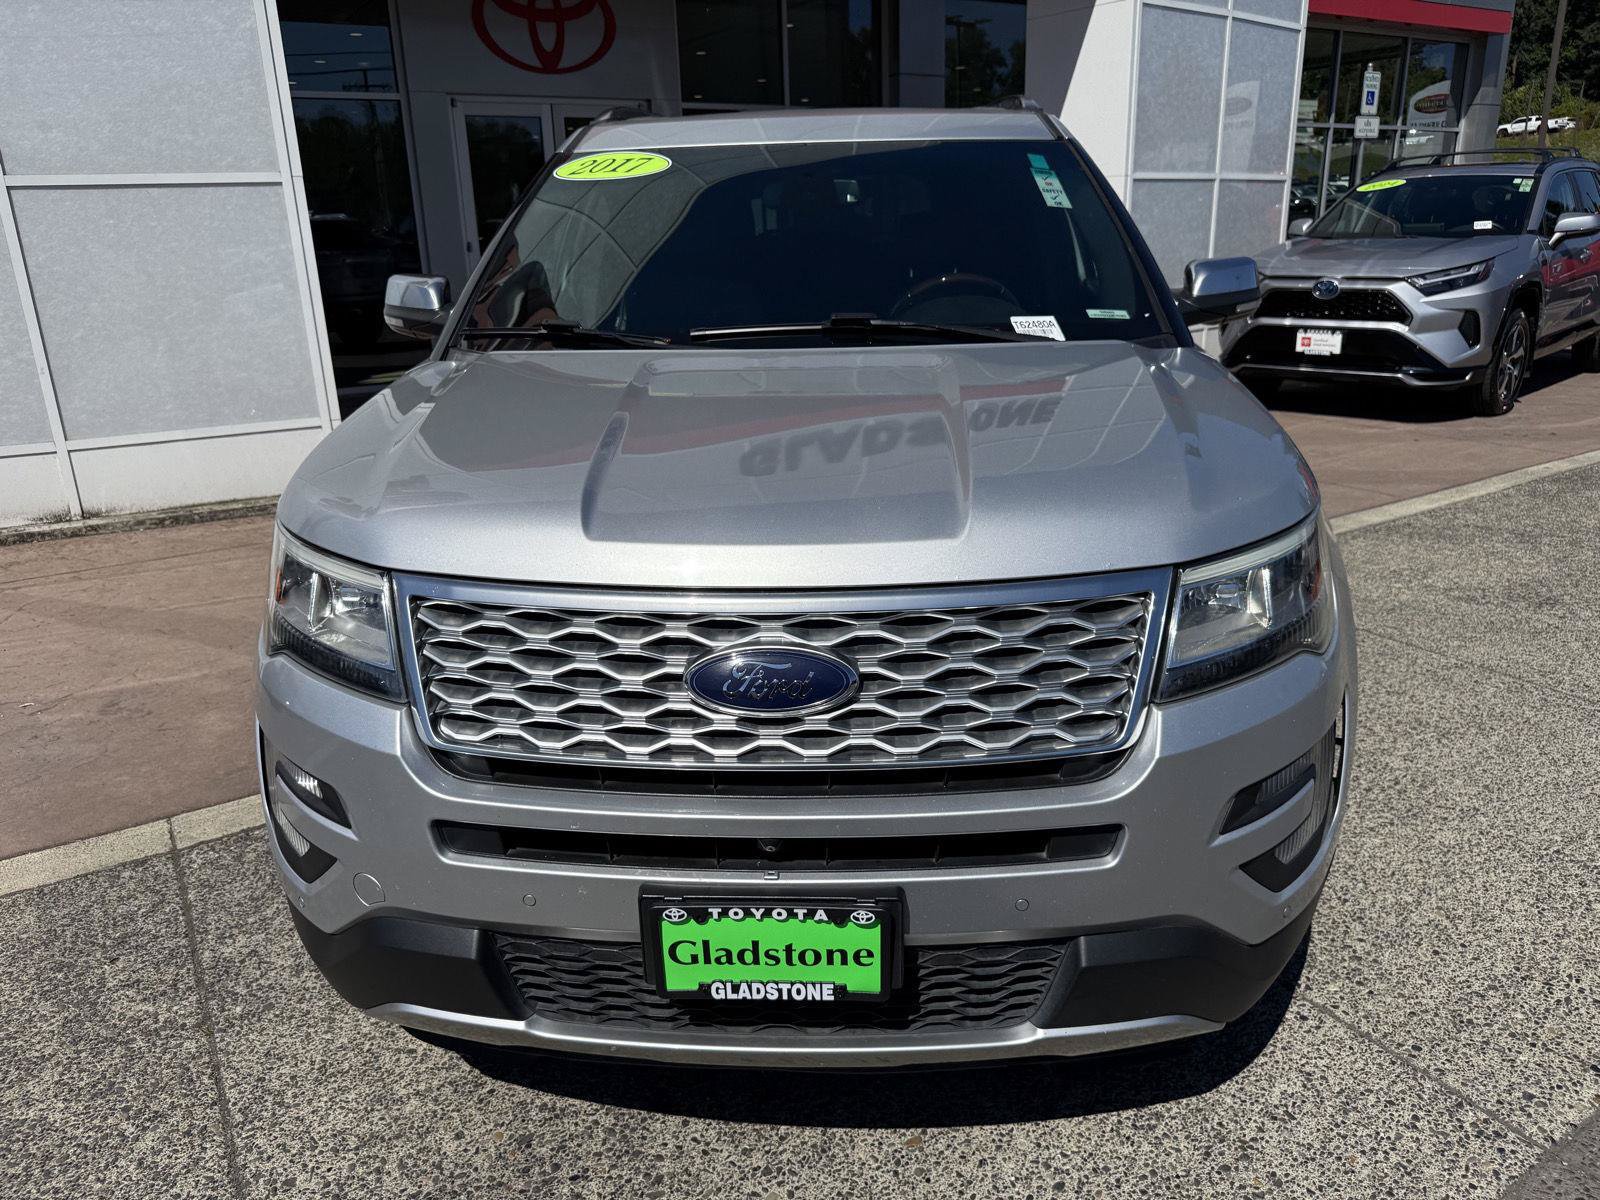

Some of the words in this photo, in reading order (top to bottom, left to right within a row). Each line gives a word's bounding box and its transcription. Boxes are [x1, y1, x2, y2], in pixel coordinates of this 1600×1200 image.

[568, 157, 655, 176] 2017
[722, 661, 816, 700] Ford
[708, 907, 829, 921] TOYOTA
[667, 939, 876, 967] Gladstone
[710, 981, 835, 1001] GLADSTONE
